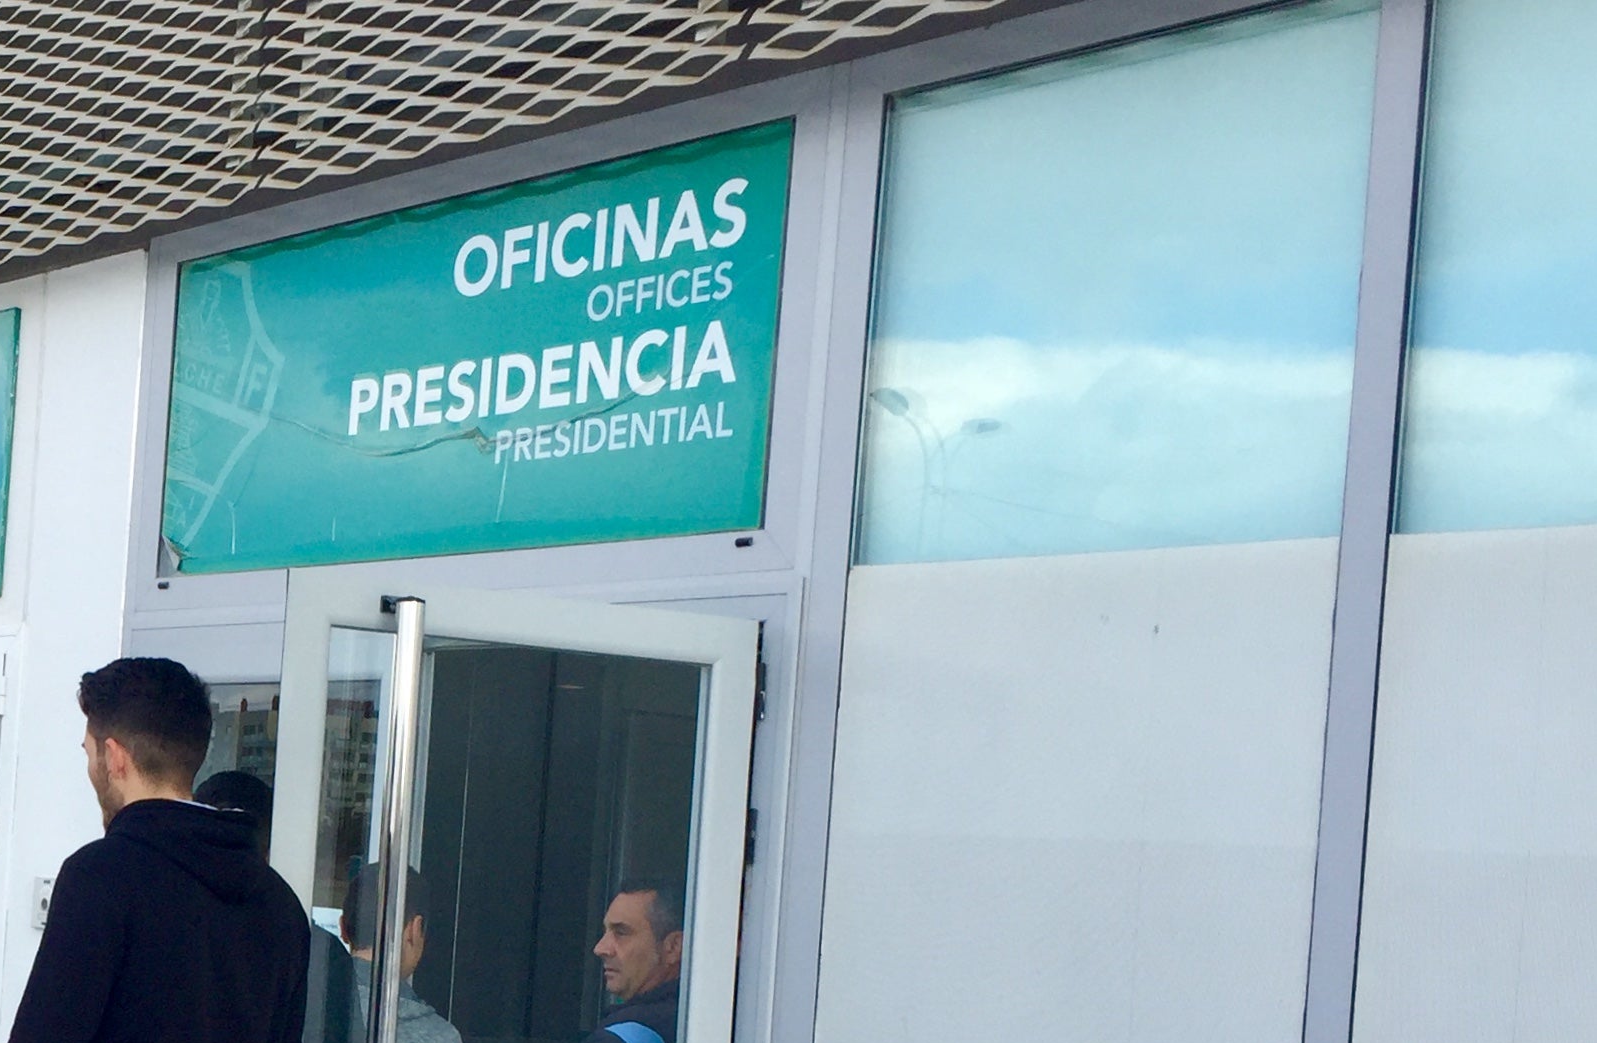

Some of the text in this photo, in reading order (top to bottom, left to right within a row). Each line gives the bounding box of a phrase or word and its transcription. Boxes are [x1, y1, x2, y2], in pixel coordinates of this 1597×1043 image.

[453, 177, 749, 298] OFICINAS
[586, 261, 734, 323] OFFICES
[347, 319, 737, 436] PRESIDENCIA
[494, 402, 734, 465] PRESIDENTIAL
